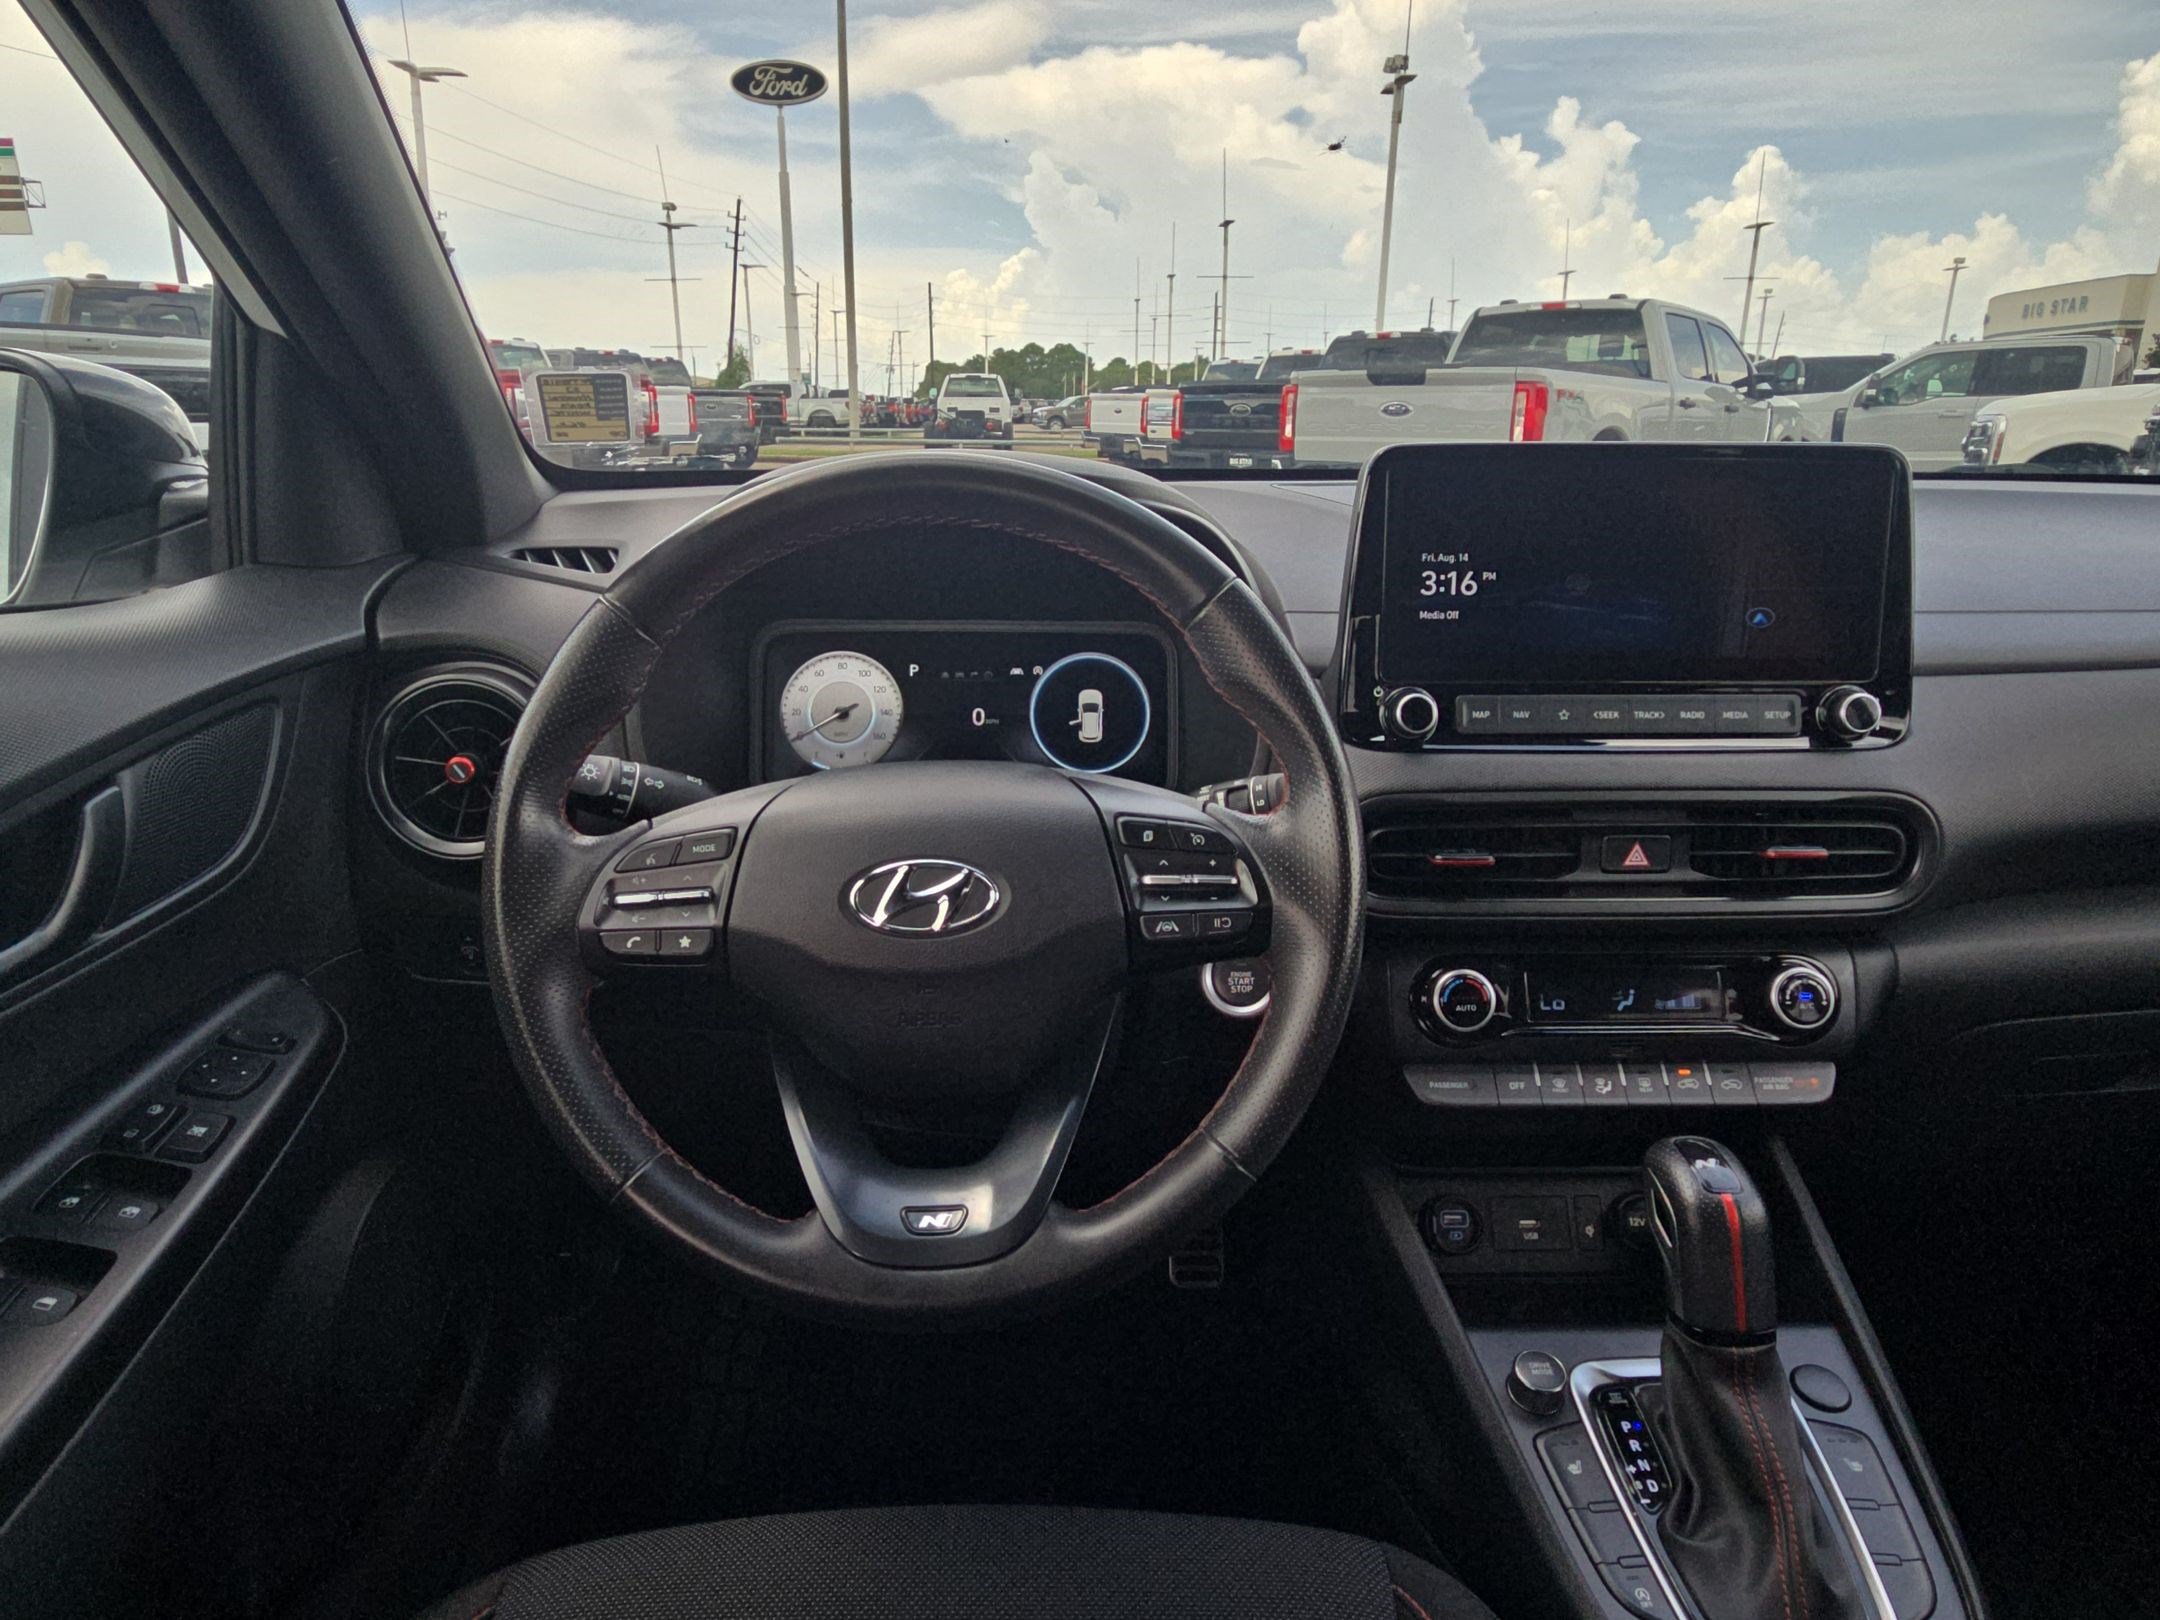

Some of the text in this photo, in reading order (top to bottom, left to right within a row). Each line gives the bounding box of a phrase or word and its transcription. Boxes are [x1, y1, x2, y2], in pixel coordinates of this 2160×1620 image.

[749, 65, 809, 96] Ford
[2022, 295, 2089, 319] BIG STAR
[1438, 553, 1457, 564] Aug.
[1459, 553, 1469, 562] 14
[1420, 570, 1497, 596] 3:16 PM
[1419, 610, 1460, 620] Media Off
[837, 662, 848, 670] 80
[909, 663, 920, 677] P
[814, 669, 825, 677] 60
[858, 669, 872, 677] 100
[799, 685, 809, 693] 40
[873, 685, 887, 693] 120
[791, 707, 802, 716] 20
[1472, 710, 1491, 719] MAP
[1512, 710, 1531, 719] NAV
[1680, 711, 1706, 719] RADIO
[1722, 711, 1749, 719] MEDIA
[1764, 711, 1792, 719] SETUP
[972, 707, 986, 726] 0
[692, 843, 717, 853] MODE
[1227, 977, 1256, 986] START
[1230, 985, 1253, 993] STOP
[1455, 1004, 1477, 1012] AUTO
[1508, 1081, 1525, 1090] OFF
[1628, 1216, 1646, 1227] 12V
[1523, 1232, 1539, 1240] USB
[1620, 1421, 1632, 1433] P
[1629, 1439, 1642, 1452] R
[1637, 1458, 1651, 1472] N
[1646, 1479, 1659, 1493] D
